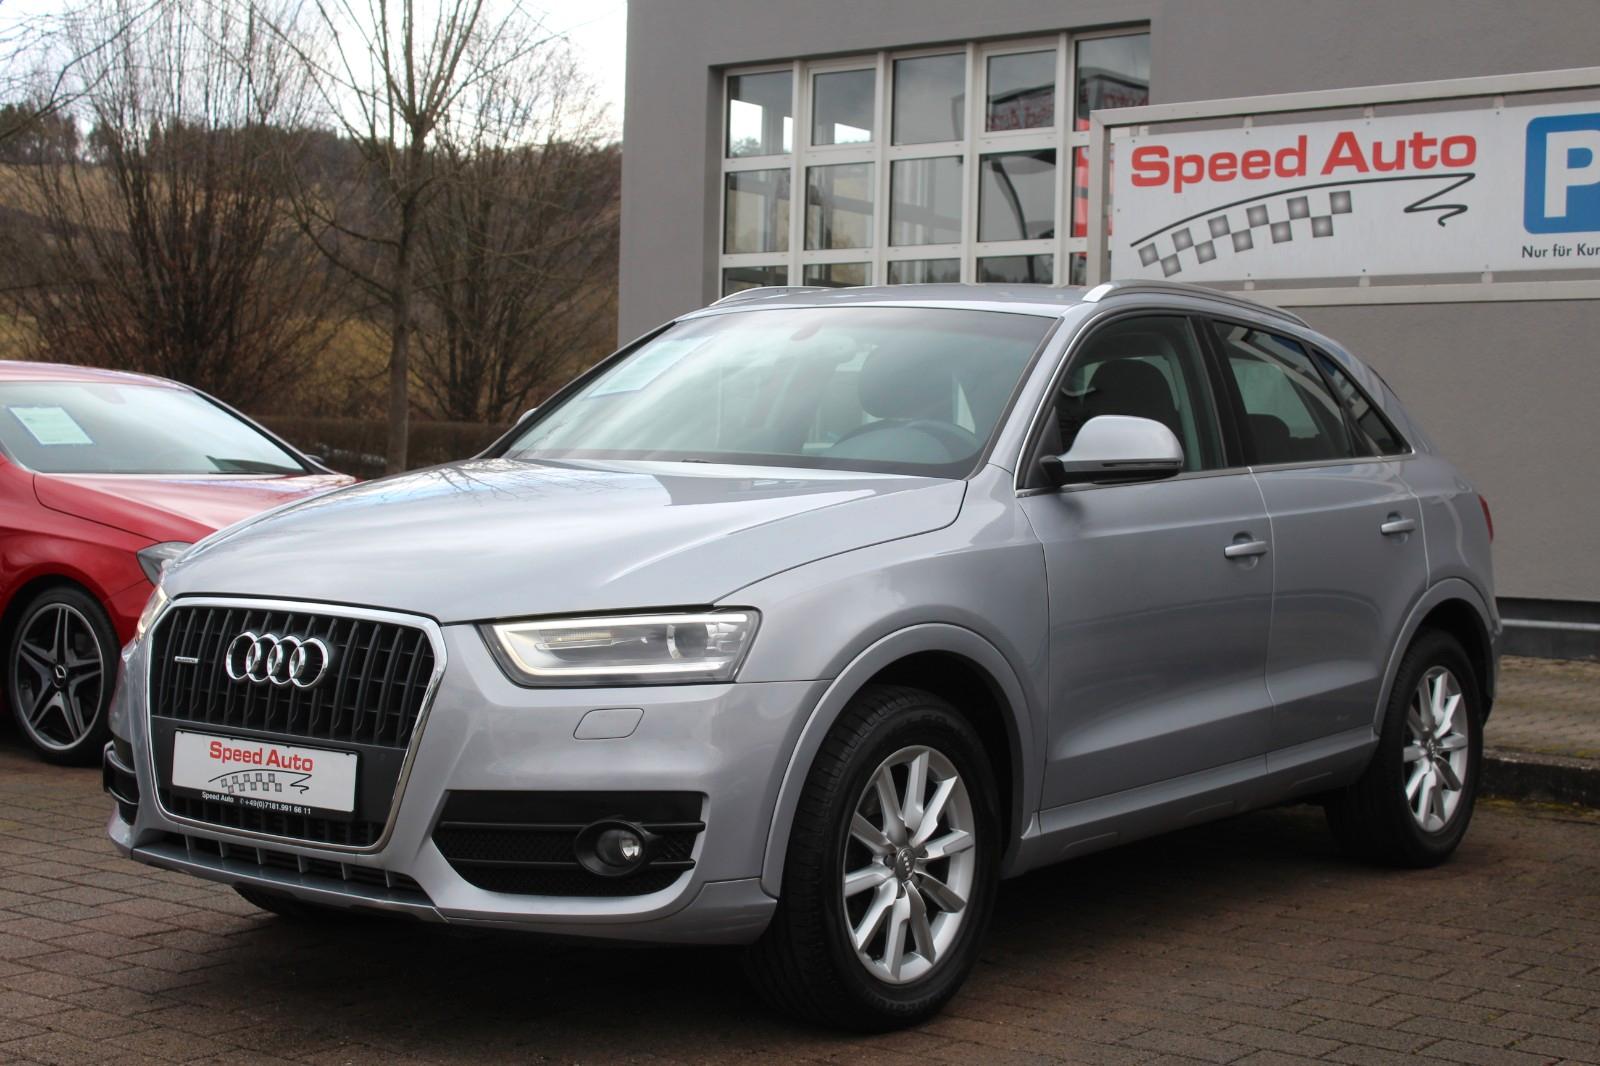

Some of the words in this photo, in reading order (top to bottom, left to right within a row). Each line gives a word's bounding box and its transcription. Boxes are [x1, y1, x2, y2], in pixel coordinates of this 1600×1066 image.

[1131, 135, 1308, 194] Speed
[1320, 130, 1477, 175] Auto
[1543, 129, 1600, 219] P
[1522, 245, 1548, 258] Nur
[1552, 243, 1572, 257] für
[210, 741, 263, 765] Speed
[266, 749, 313, 772] Auto
[202, 791, 219, 801] Speed
[221, 795, 234, 803] Auto
[304, 807, 311, 815] 11
